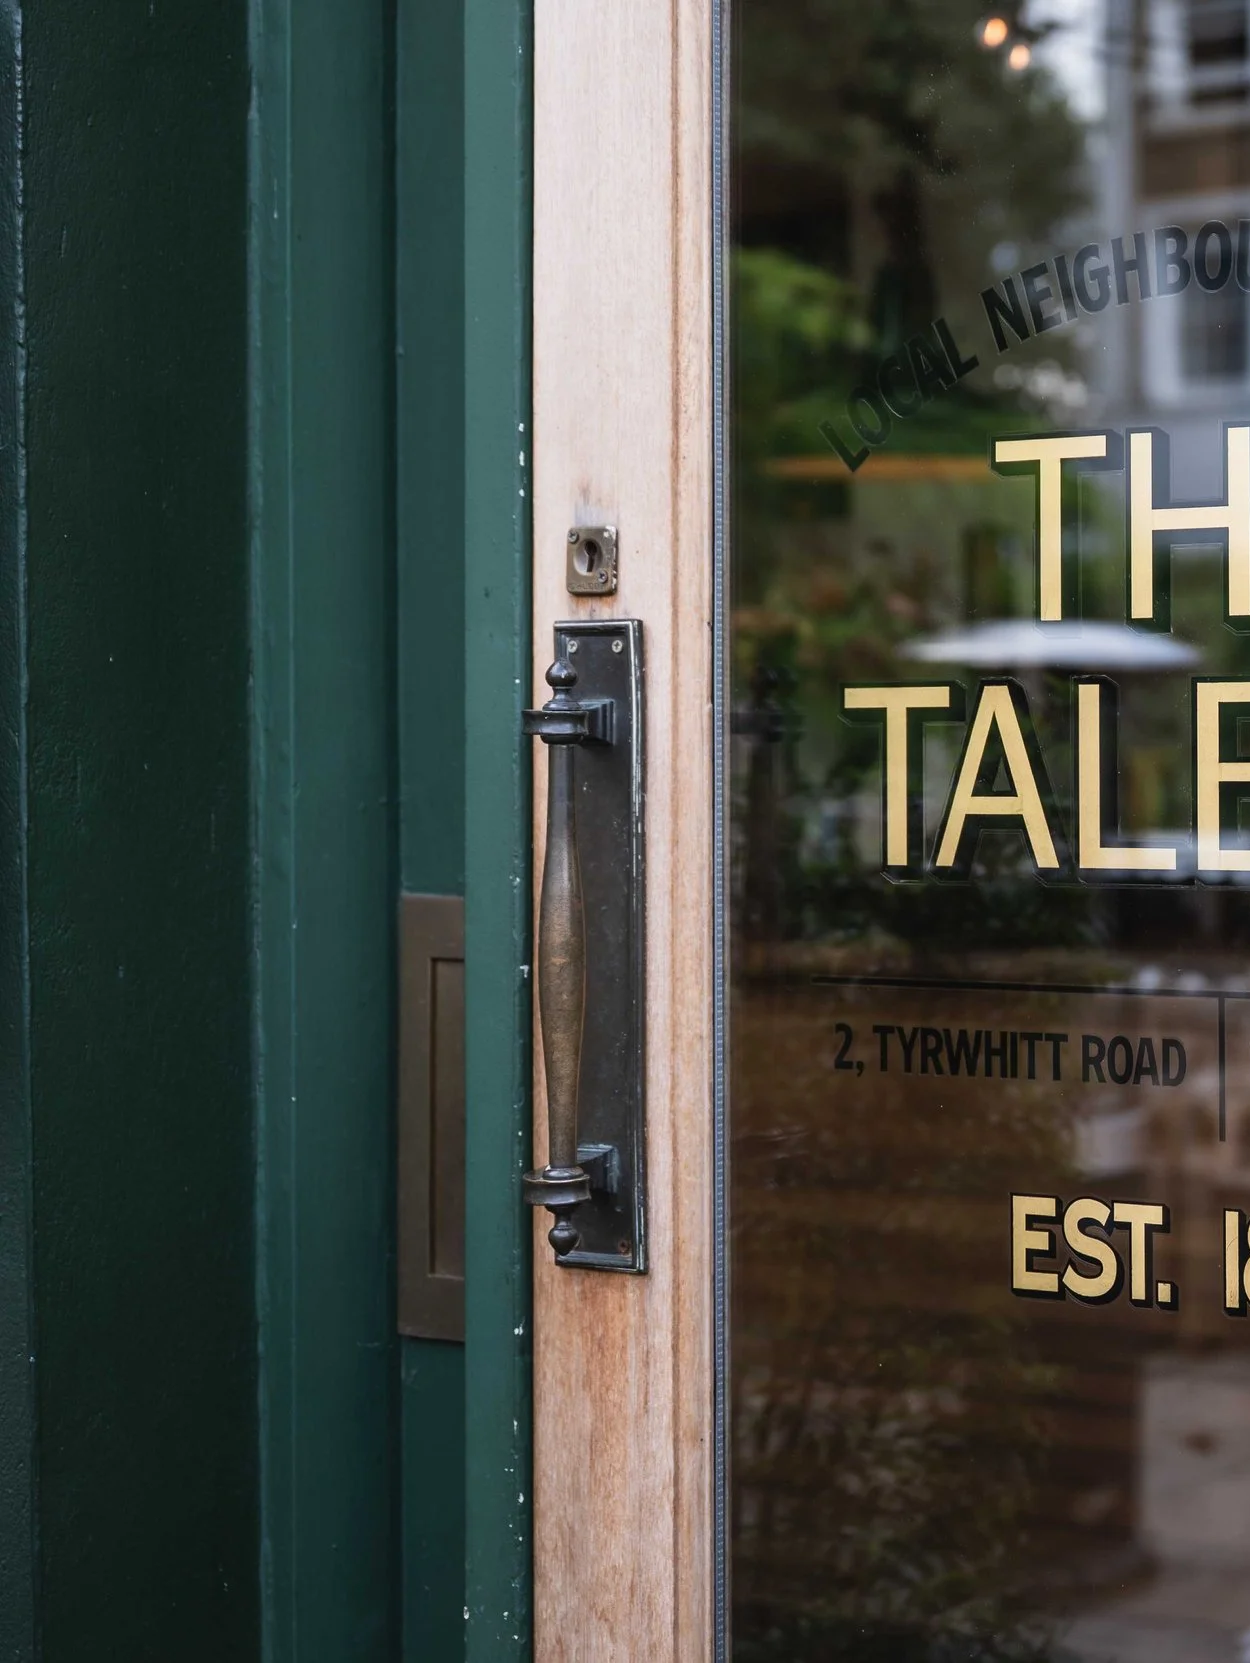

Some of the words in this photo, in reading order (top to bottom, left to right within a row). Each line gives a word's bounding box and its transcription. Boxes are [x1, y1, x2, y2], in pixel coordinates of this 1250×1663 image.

[818, 318, 979, 472] LOCAL
[834, 1023, 864, 1076] 2,
[872, 1025, 1069, 1081] TYRWHITT
[1081, 1035, 1187, 1086] ROAD
[1011, 1195, 1175, 1305] EST.
